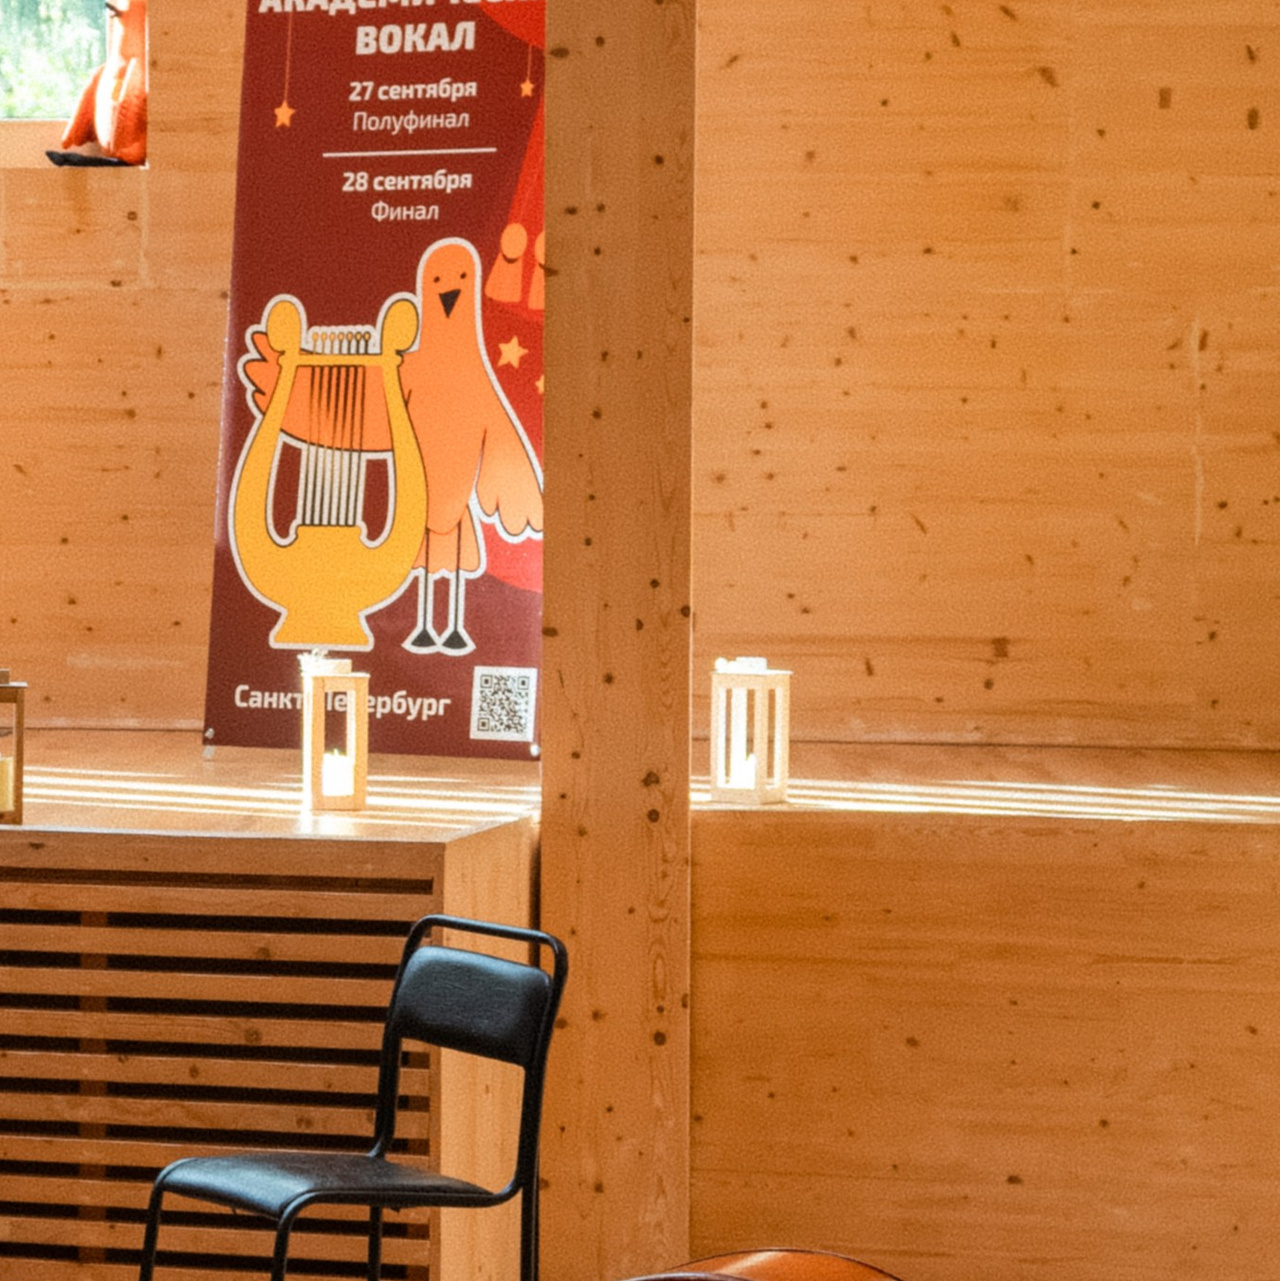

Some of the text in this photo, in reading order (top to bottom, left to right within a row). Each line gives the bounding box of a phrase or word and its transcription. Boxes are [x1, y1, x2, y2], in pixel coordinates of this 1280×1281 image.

[355, 21, 476, 55] ВОКАЛ
[348, 78, 477, 102] 27 сентября
[353, 109, 470, 135] Полуфинал
[342, 169, 472, 194] 28 сентября
[371, 199, 439, 222] Финал
